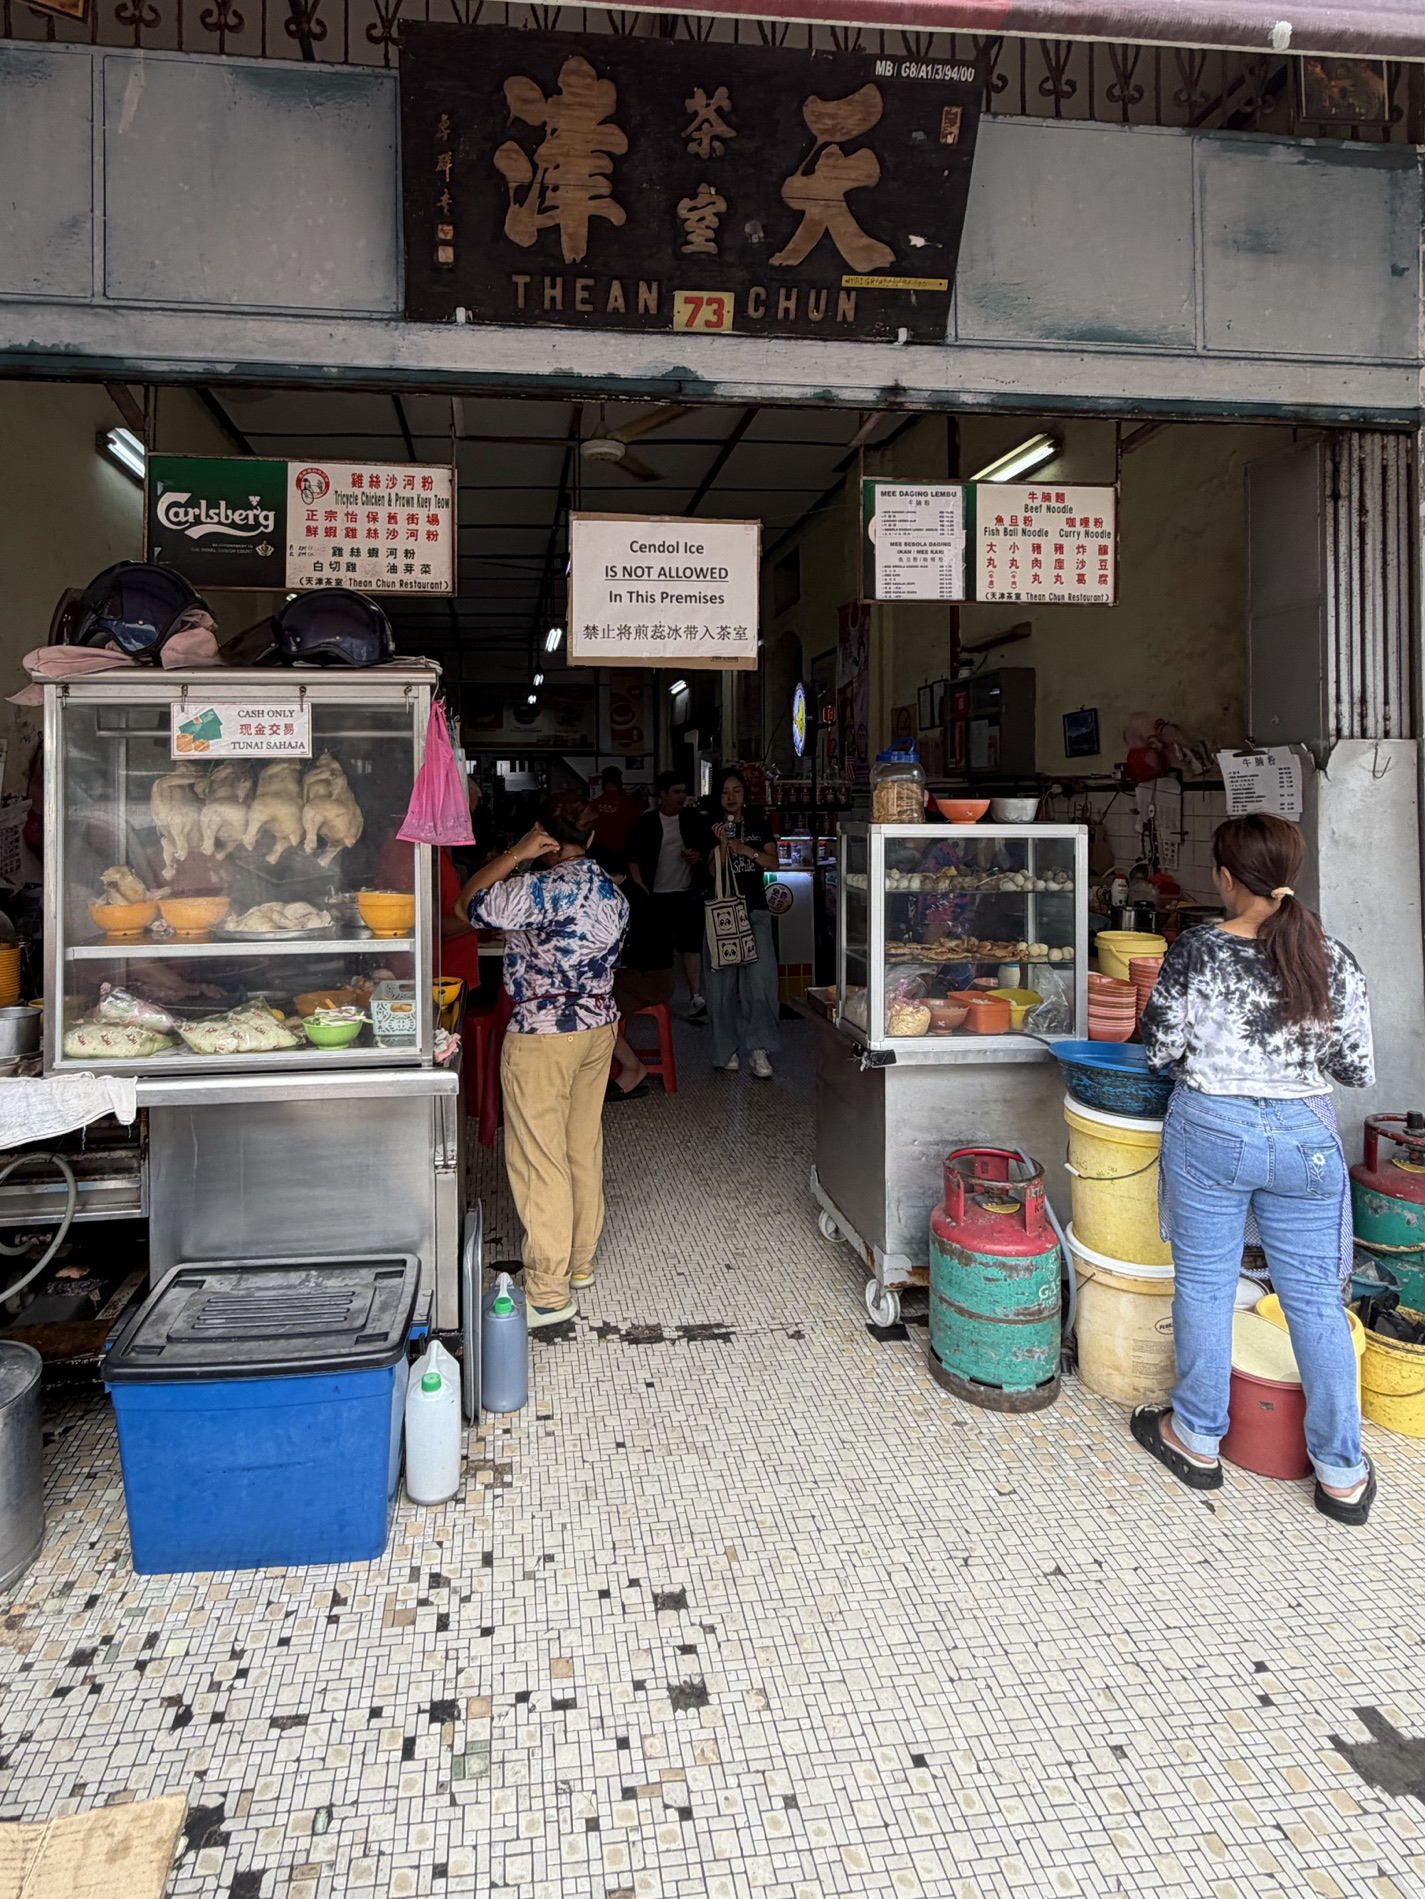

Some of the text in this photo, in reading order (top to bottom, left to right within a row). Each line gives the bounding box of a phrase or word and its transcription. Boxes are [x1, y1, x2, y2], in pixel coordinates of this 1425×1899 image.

[512, 274, 858, 322] THEAN CHUN
[683, 296, 726, 328] 73
[334, 490, 450, 511] Tricycle Chicken & Prawn Kuey Teow
[156, 492, 276, 535] Carlsberg
[1024, 504, 1074, 514] Beef Noodle
[984, 526, 1049, 538] Fish Ball Noodle
[1059, 528, 1112, 540] Curry Noodle
[630, 540, 704, 554] Cendol Ice
[604, 565, 729, 580] IS NOT ALLOWED
[350, 578, 373, 588] Thean
[376, 579, 396, 589] Chun
[609, 590, 725, 605] In This Premises
[1026, 592, 1046, 601] Thean
[1048, 592, 1065, 601] Chun
[238, 709, 295, 718] CASH ONLY
[239, 723, 294, 736] 现金交易
[231, 741, 306, 750] TUNAI SAHAJA
